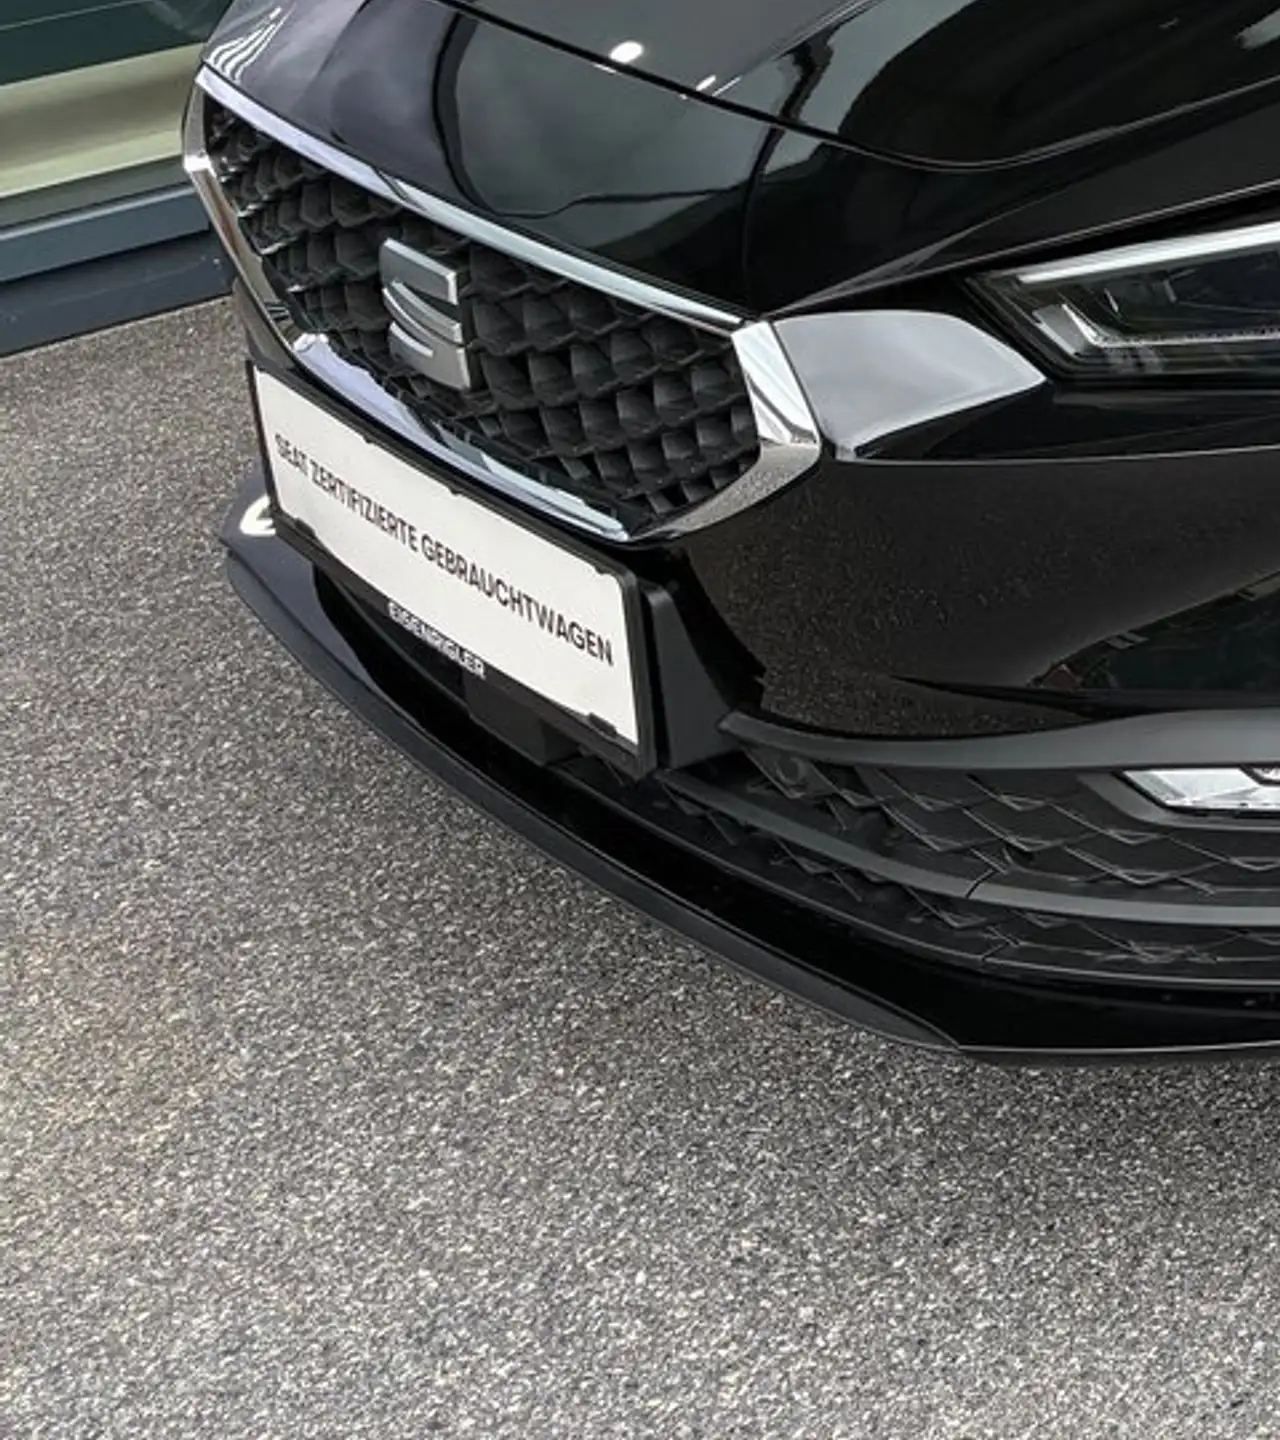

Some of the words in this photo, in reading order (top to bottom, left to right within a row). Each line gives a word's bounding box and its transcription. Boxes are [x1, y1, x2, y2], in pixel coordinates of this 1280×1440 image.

[274, 432, 309, 476] SEAT
[309, 459, 419, 553] ZERTIFIZIERTE
[421, 533, 615, 667] GEBRAUCHTWAGEN
